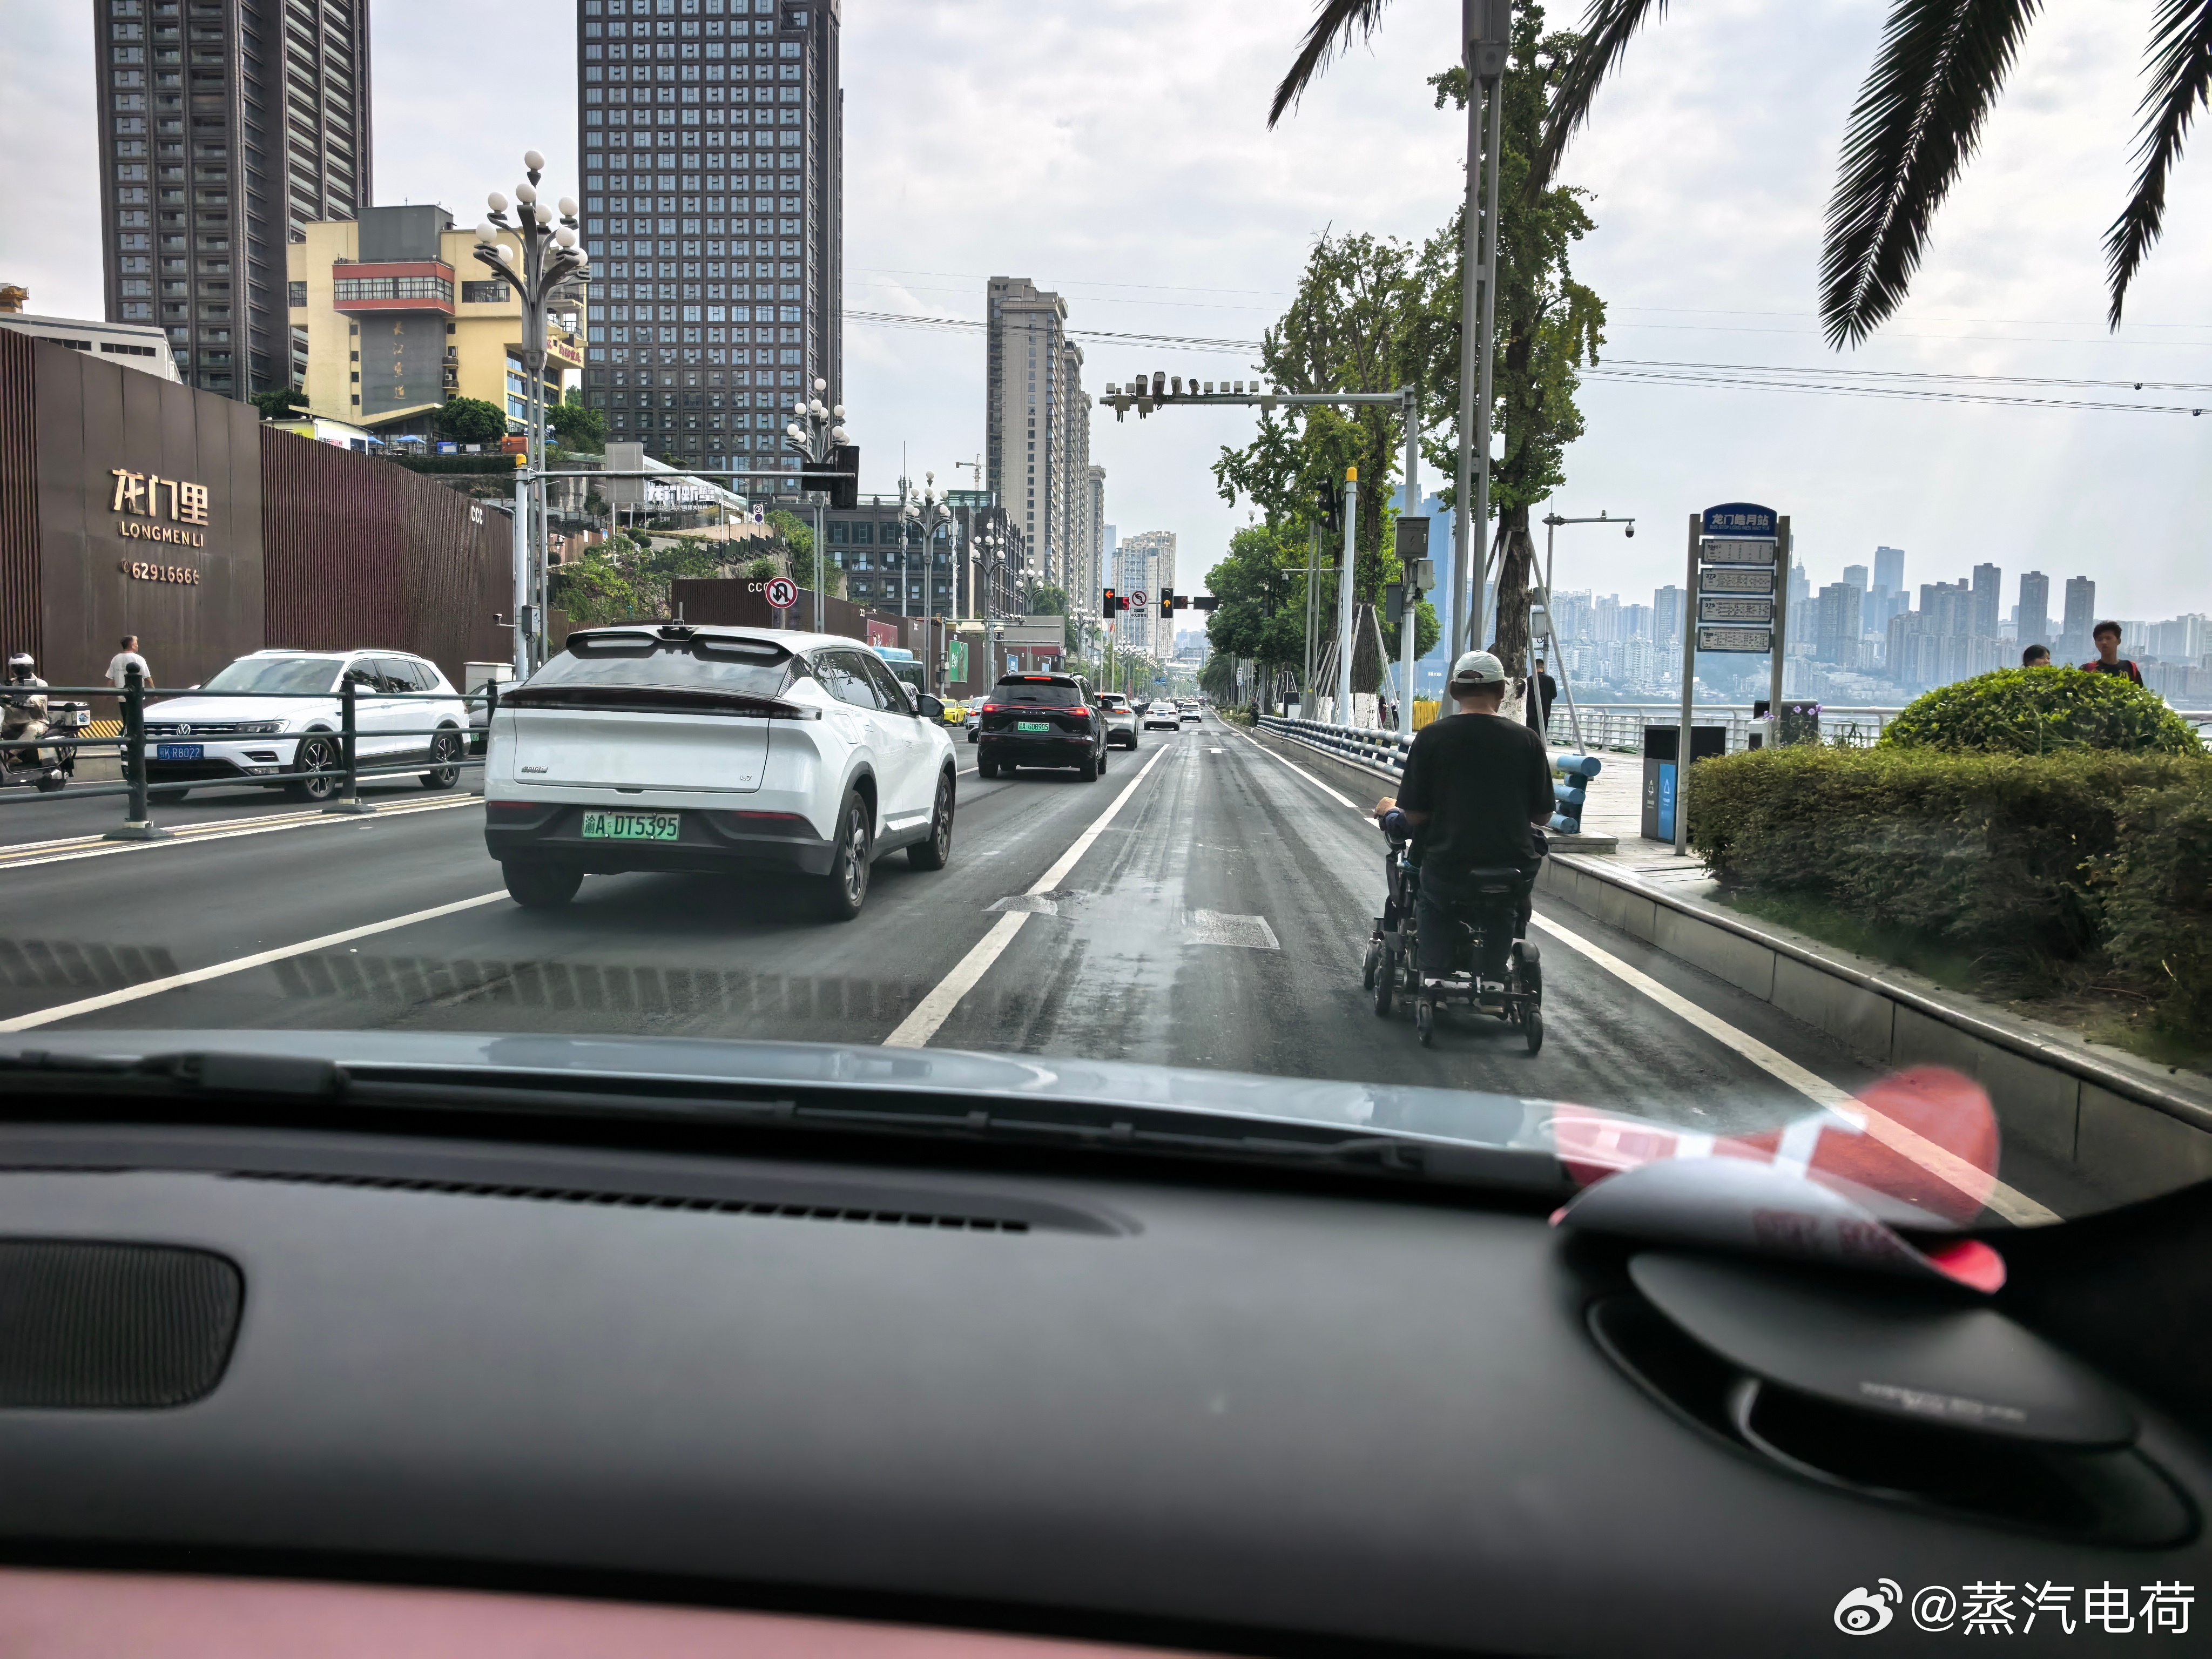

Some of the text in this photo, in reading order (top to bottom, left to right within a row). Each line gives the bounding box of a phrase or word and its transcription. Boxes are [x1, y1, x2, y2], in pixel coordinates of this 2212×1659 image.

[111, 469, 209, 526] 龙门里
[471, 505, 483, 525] CCC
[1712, 514, 1769, 526] 龙门皓月站
[132, 562, 200, 585] 62916666
[1123, 598, 1129, 609] 5
